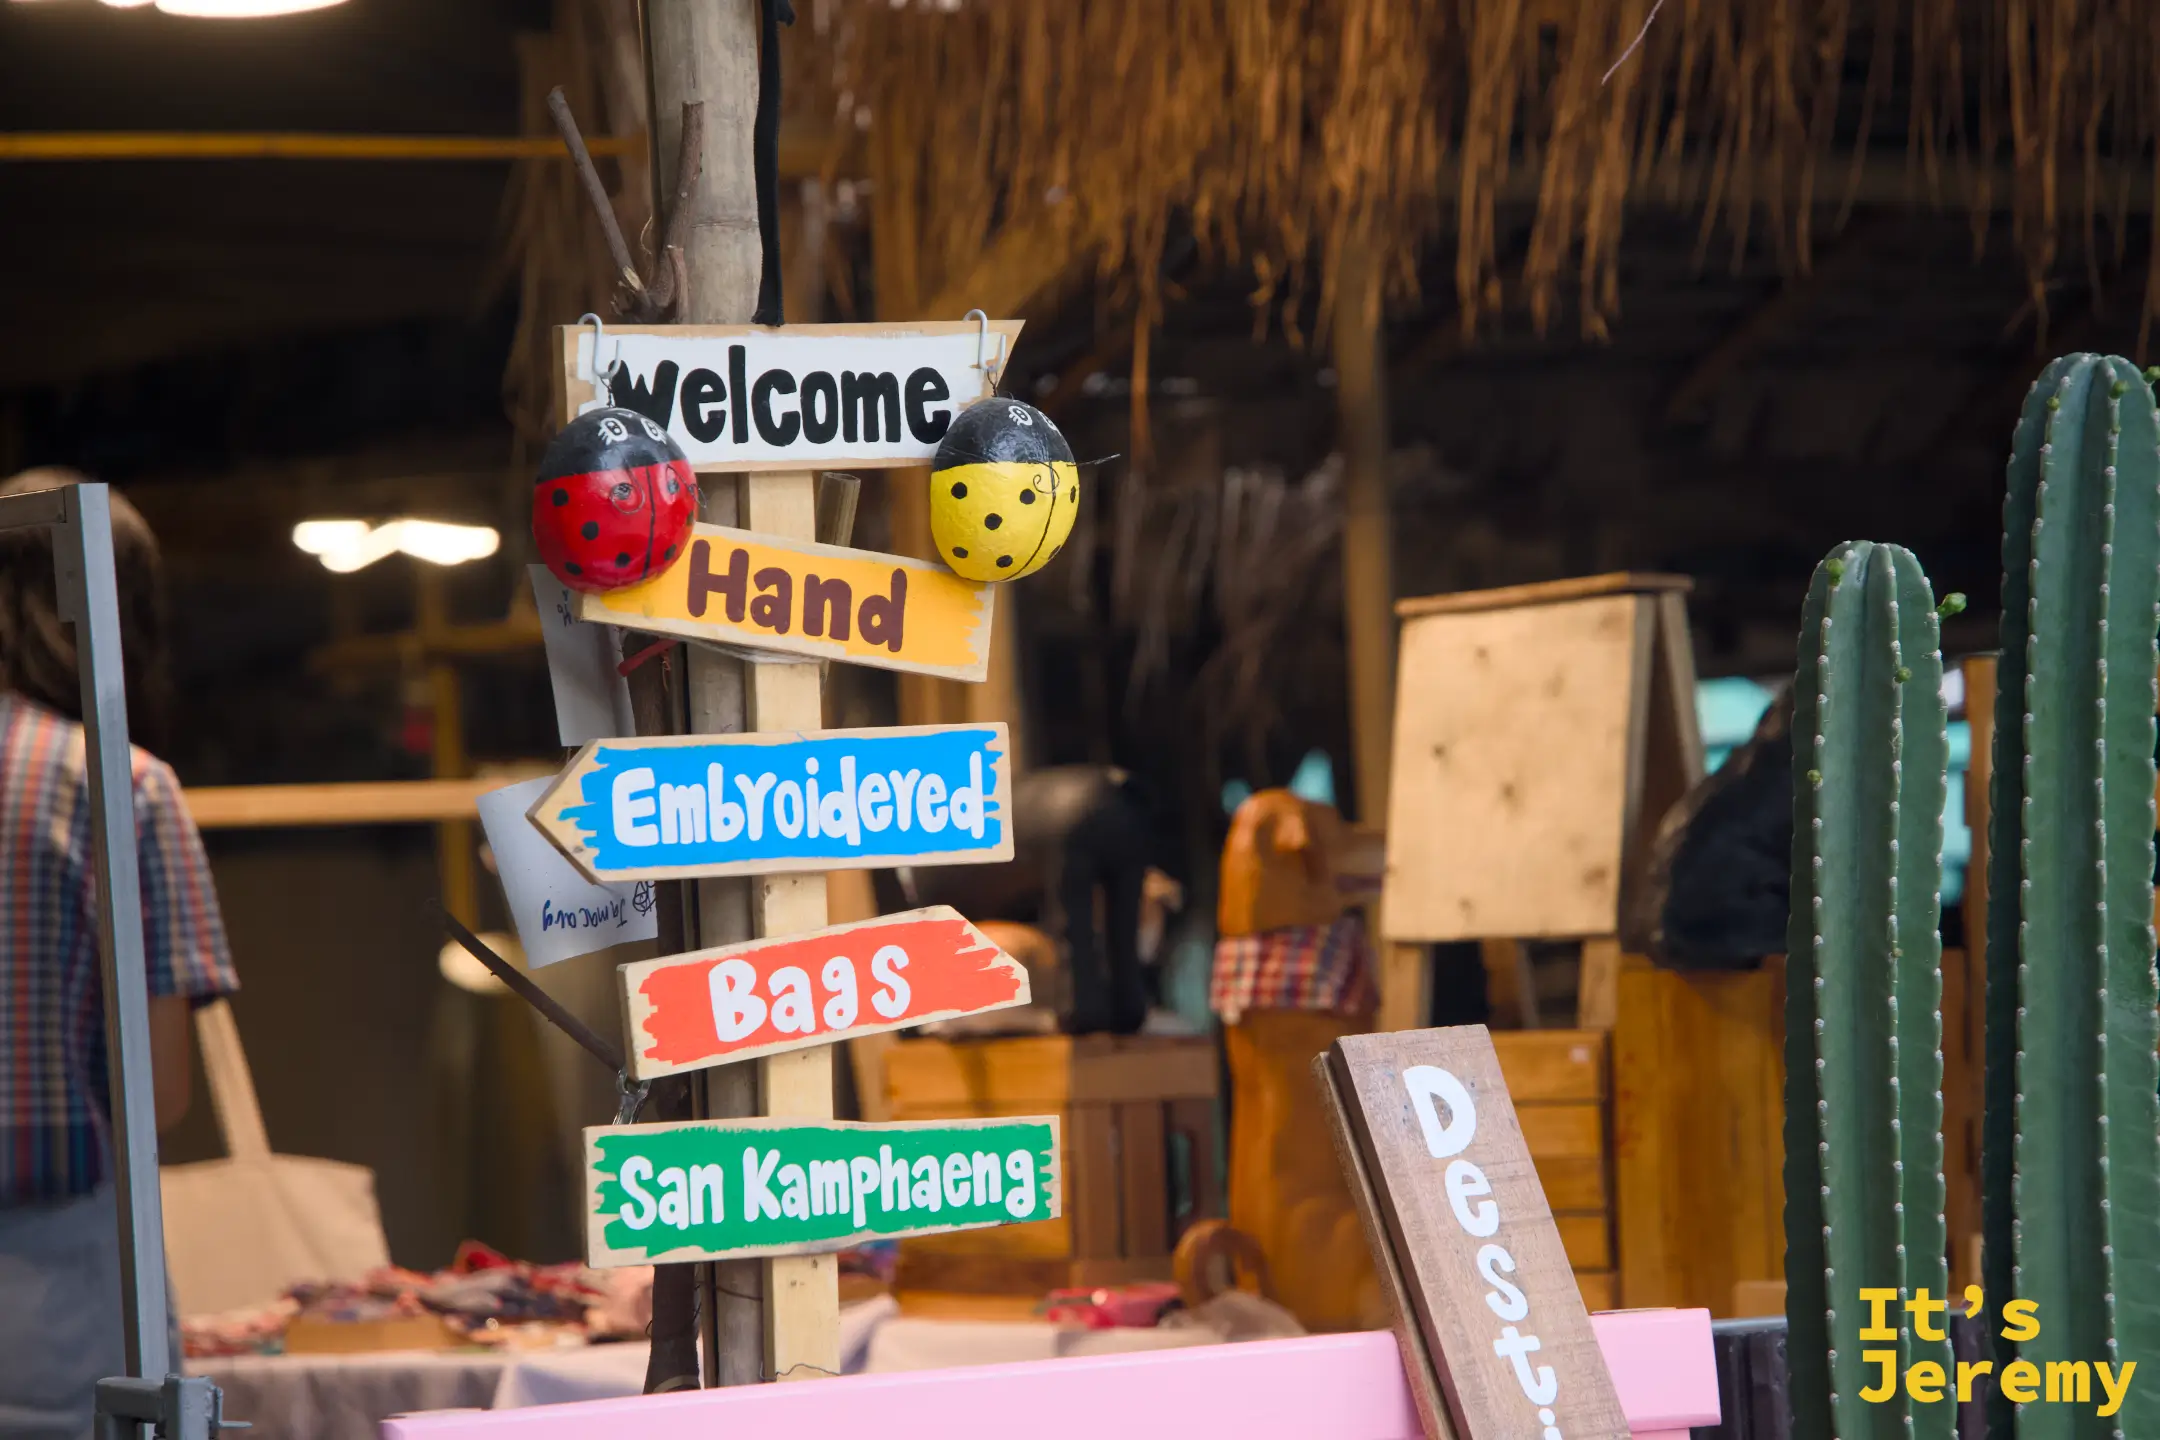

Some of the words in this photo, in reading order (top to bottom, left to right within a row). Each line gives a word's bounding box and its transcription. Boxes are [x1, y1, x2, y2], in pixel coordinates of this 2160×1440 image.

[688, 539, 908, 653] Hand
[612, 750, 985, 847] Embroidered
[708, 945, 912, 1043] Bags
[619, 1156, 725, 1231] San
[742, 1144, 1037, 1228] Kamphaeng
